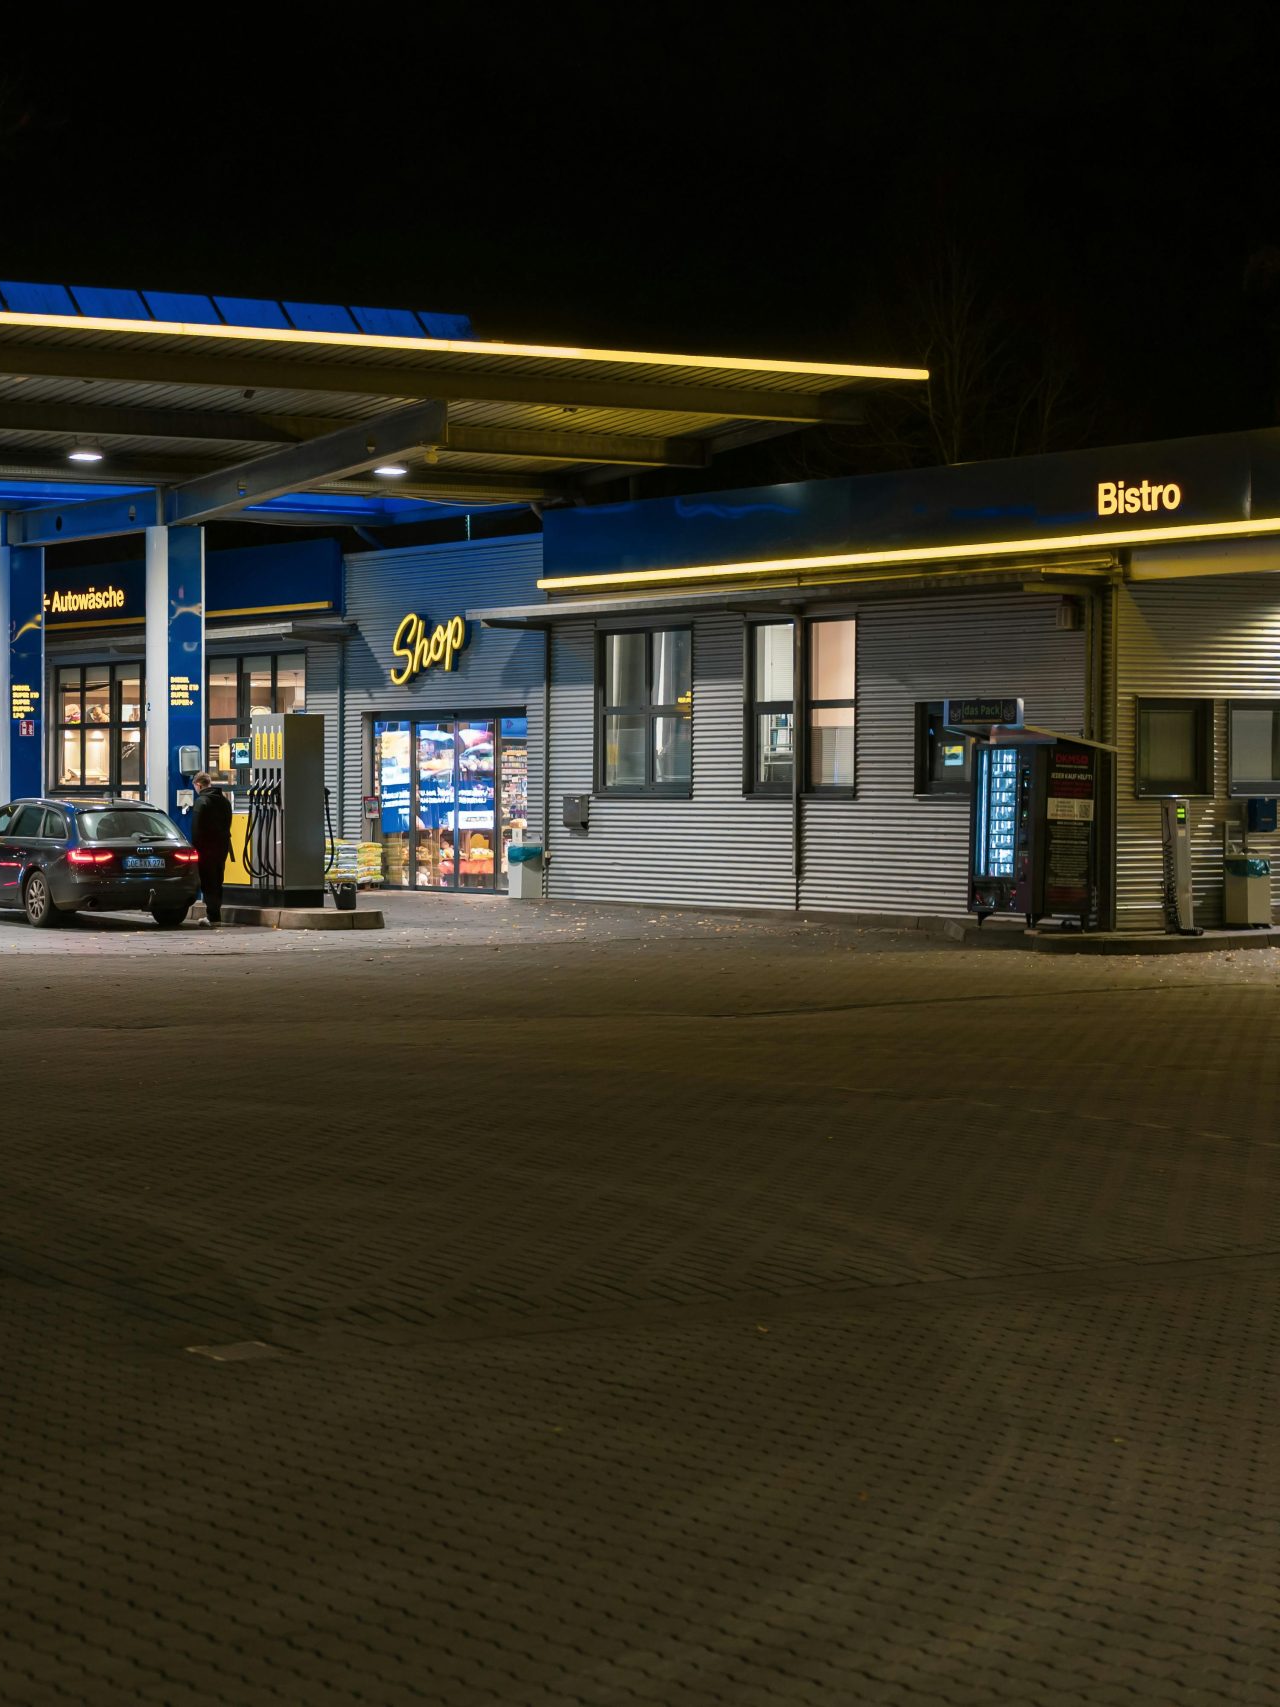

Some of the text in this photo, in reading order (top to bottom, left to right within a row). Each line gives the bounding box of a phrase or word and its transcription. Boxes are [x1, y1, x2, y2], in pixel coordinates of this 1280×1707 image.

[1098, 480, 1181, 516] Bistro
[51, 585, 125, 613] Autowäsche
[390, 612, 465, 686] Shop
